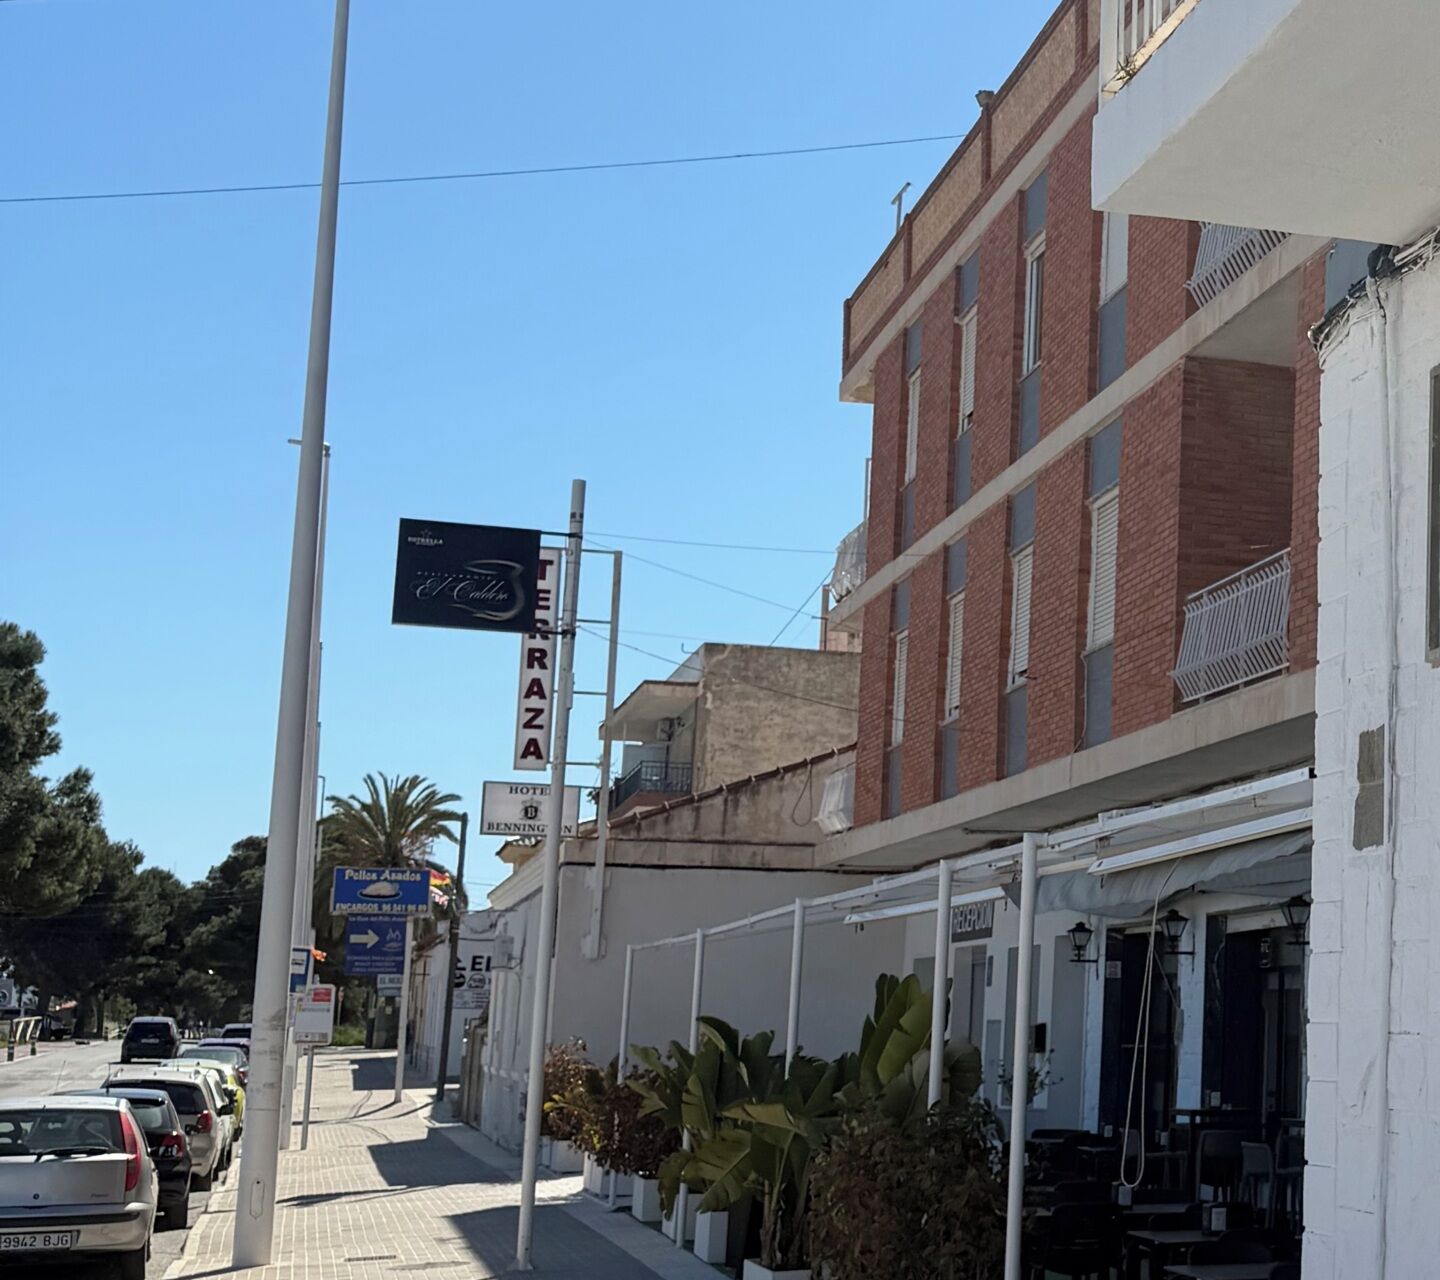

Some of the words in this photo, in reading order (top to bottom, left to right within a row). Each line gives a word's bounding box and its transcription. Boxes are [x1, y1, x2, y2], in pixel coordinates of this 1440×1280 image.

[509, 785, 551, 796] HOTE
[487, 822, 573, 834] BENNINGN
[3, 1235, 37, 1249] 9942
[43, 1233, 69, 1247] BJG
